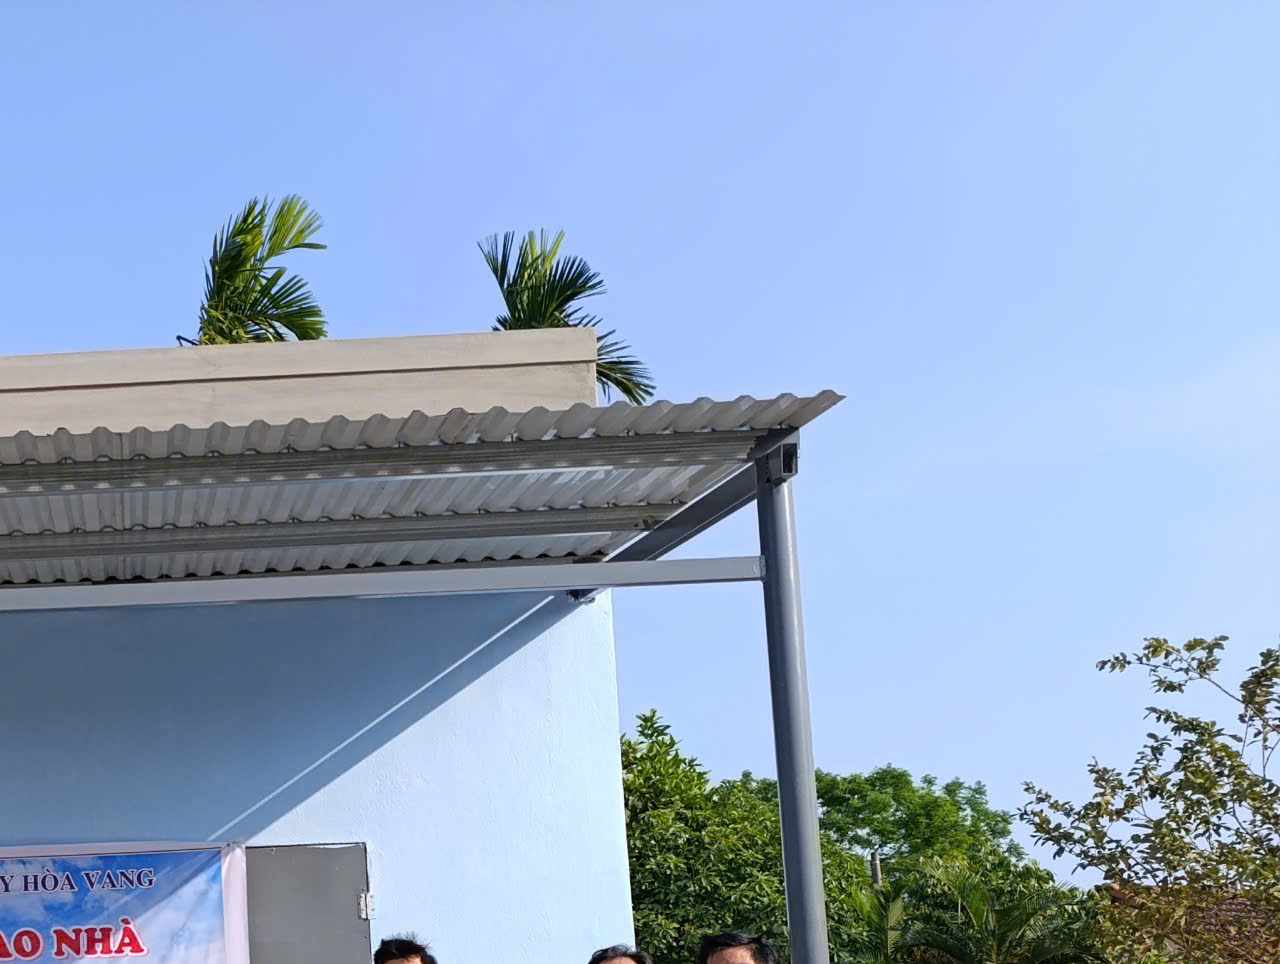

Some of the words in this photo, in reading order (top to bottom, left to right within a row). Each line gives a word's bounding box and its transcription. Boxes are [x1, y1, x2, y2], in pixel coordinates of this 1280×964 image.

[23, 868, 76, 892] HÒA
[82, 868, 155, 889] VANG
[53, 918, 145, 957] NHÀ
